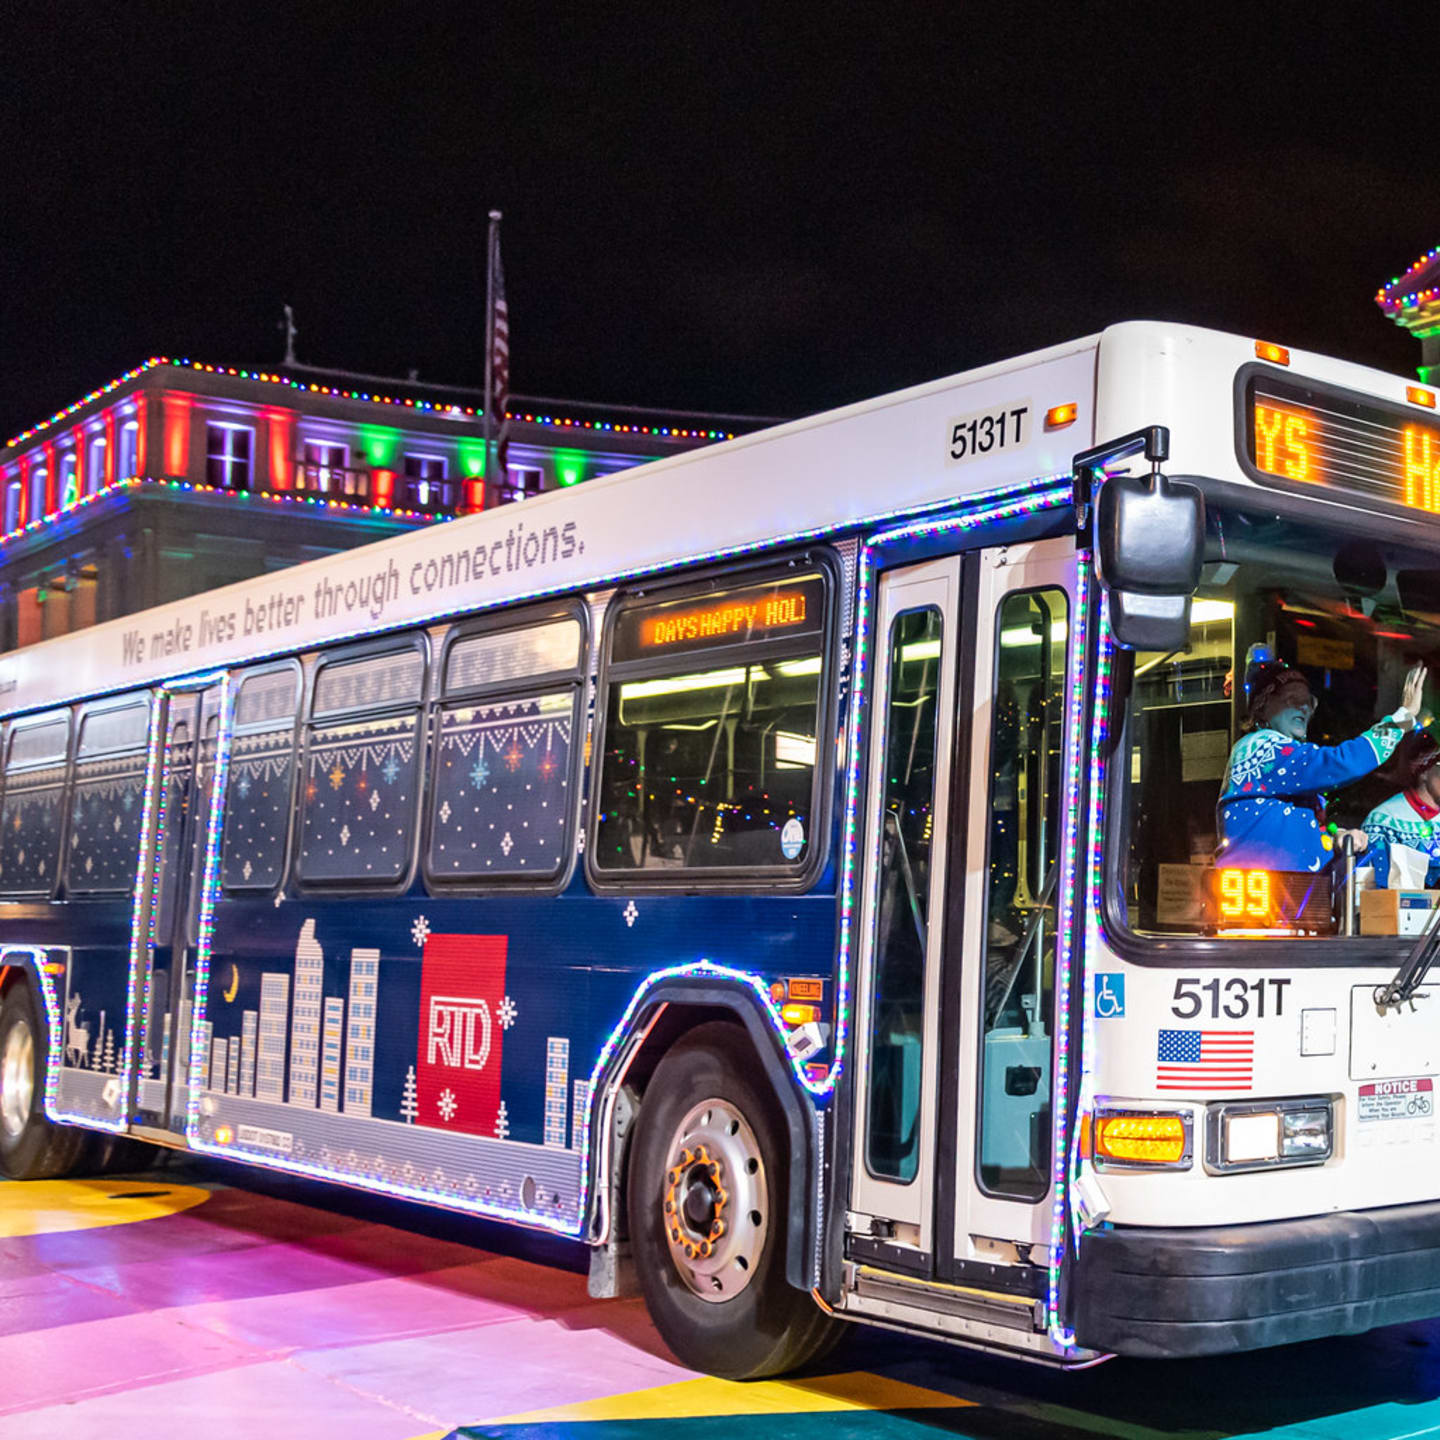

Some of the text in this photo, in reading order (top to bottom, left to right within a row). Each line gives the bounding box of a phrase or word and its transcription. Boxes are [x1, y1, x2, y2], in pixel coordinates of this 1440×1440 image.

[950, 406, 1028, 460] 5131T
[122, 521, 585, 666] We make lives better through connections.
[1220, 867, 1271, 917] 99
[1171, 977, 1292, 1019] 5131T
[427, 995, 492, 1071] RTD
[1374, 1079, 1418, 1096] NOTICE
